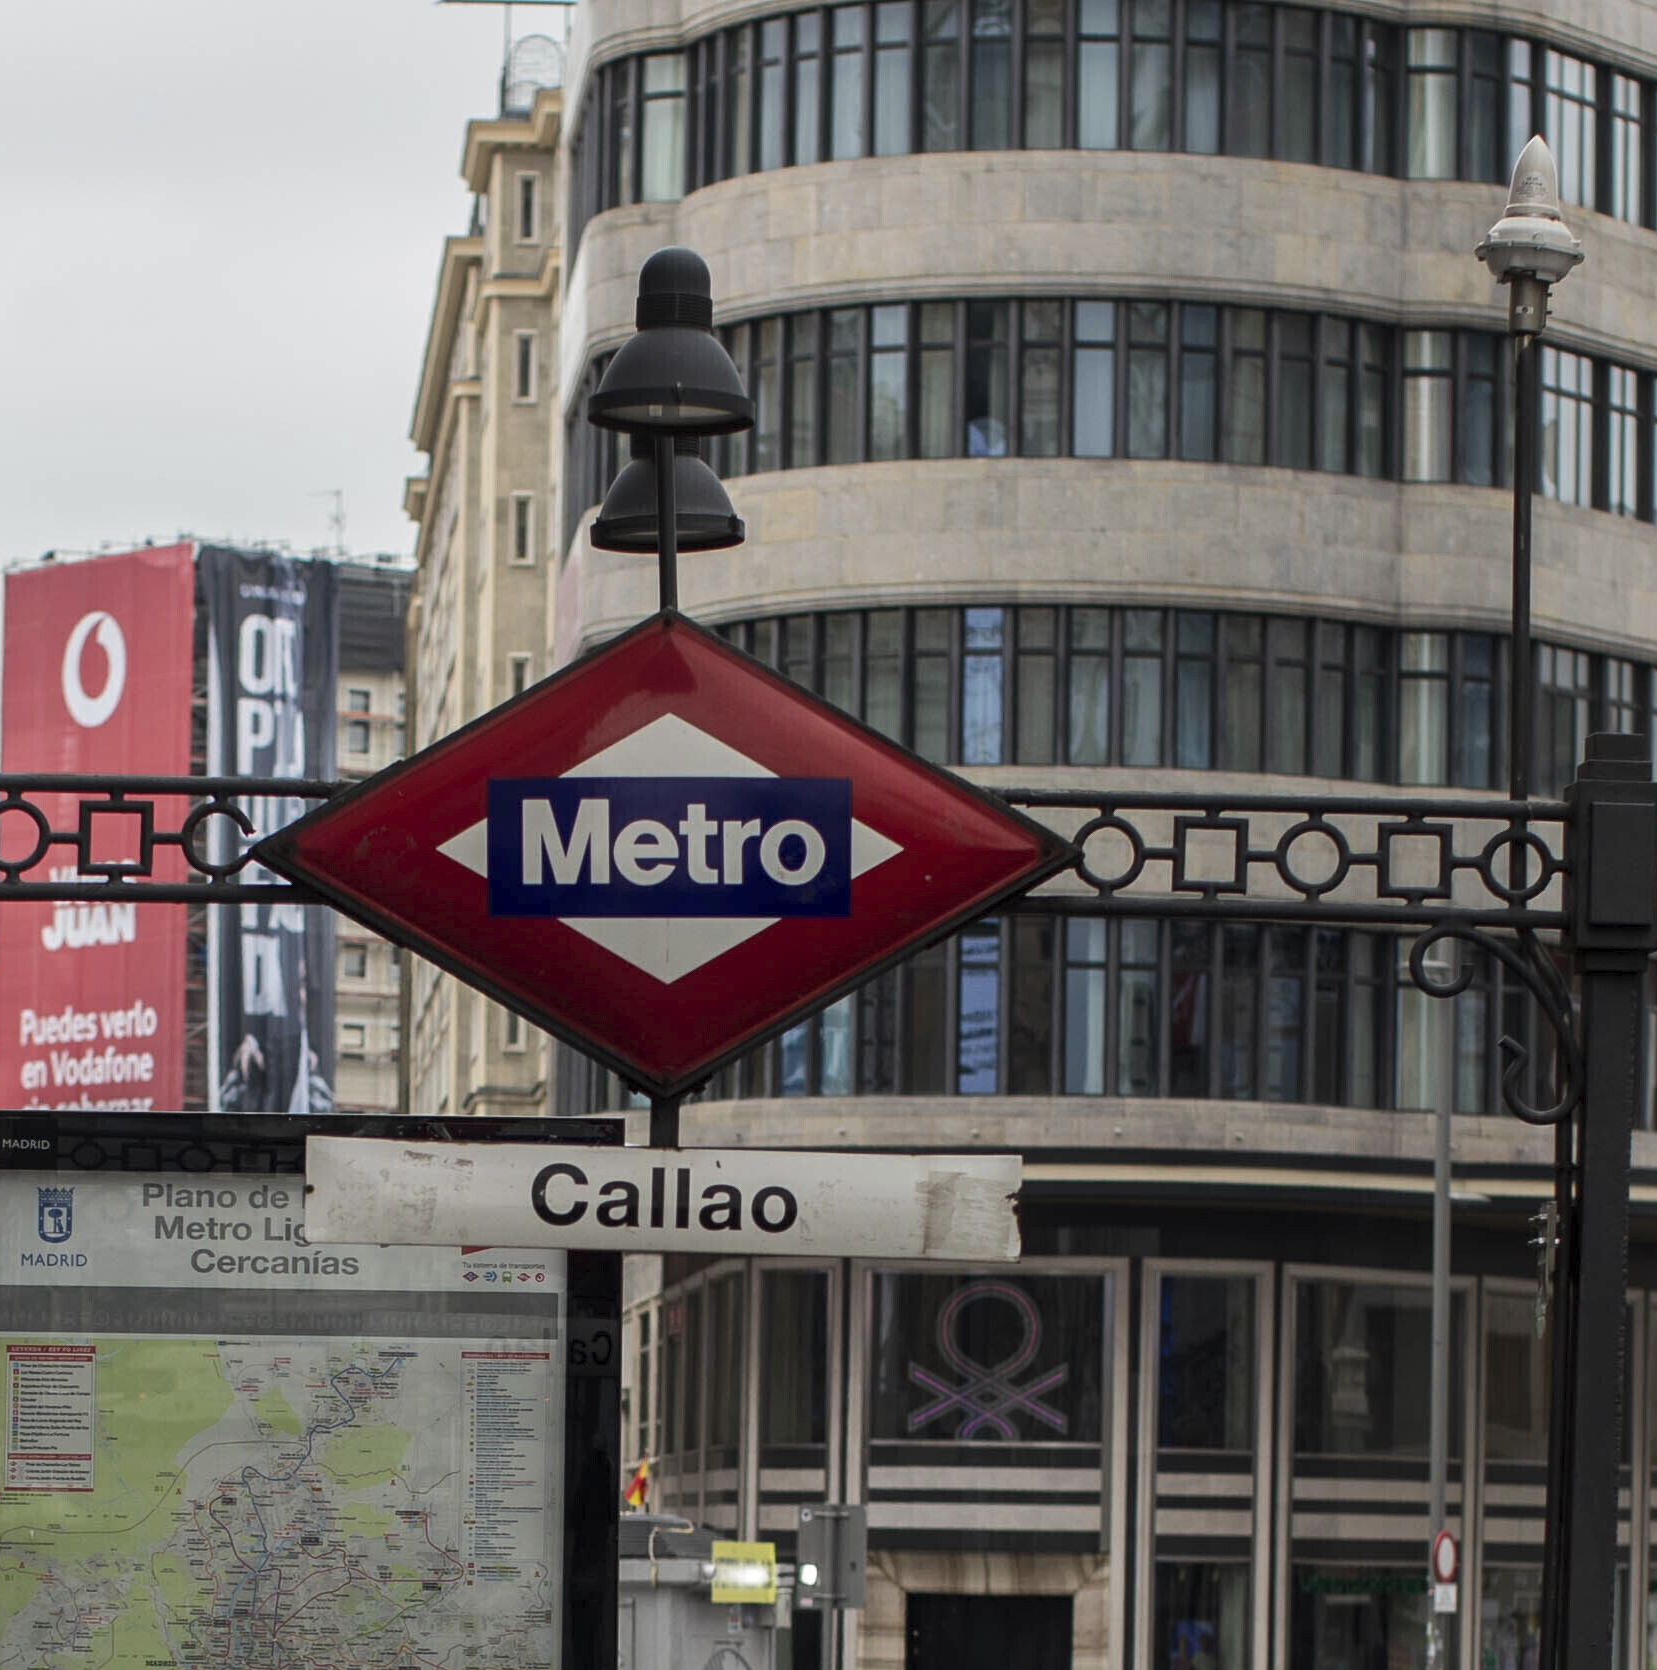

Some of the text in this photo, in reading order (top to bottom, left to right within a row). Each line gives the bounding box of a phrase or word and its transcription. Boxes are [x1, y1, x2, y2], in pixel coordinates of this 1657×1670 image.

[521, 798, 827, 887] Metro
[42, 904, 137, 952] JUAN
[20, 1000, 158, 1047] Puedes verlo
[20, 1045, 154, 1090] en Vodafone
[1, 1138, 51, 1150] MADRID
[141, 1182, 290, 1210] Plano de
[530, 1161, 799, 1234] Callao
[154, 1215, 253, 1241] Metro
[20, 1253, 89, 1268] MADRID
[191, 1248, 360, 1275] Cercanías
[462, 1261, 471, 1269] Tu
[508, 1263, 546, 1271] transportes
